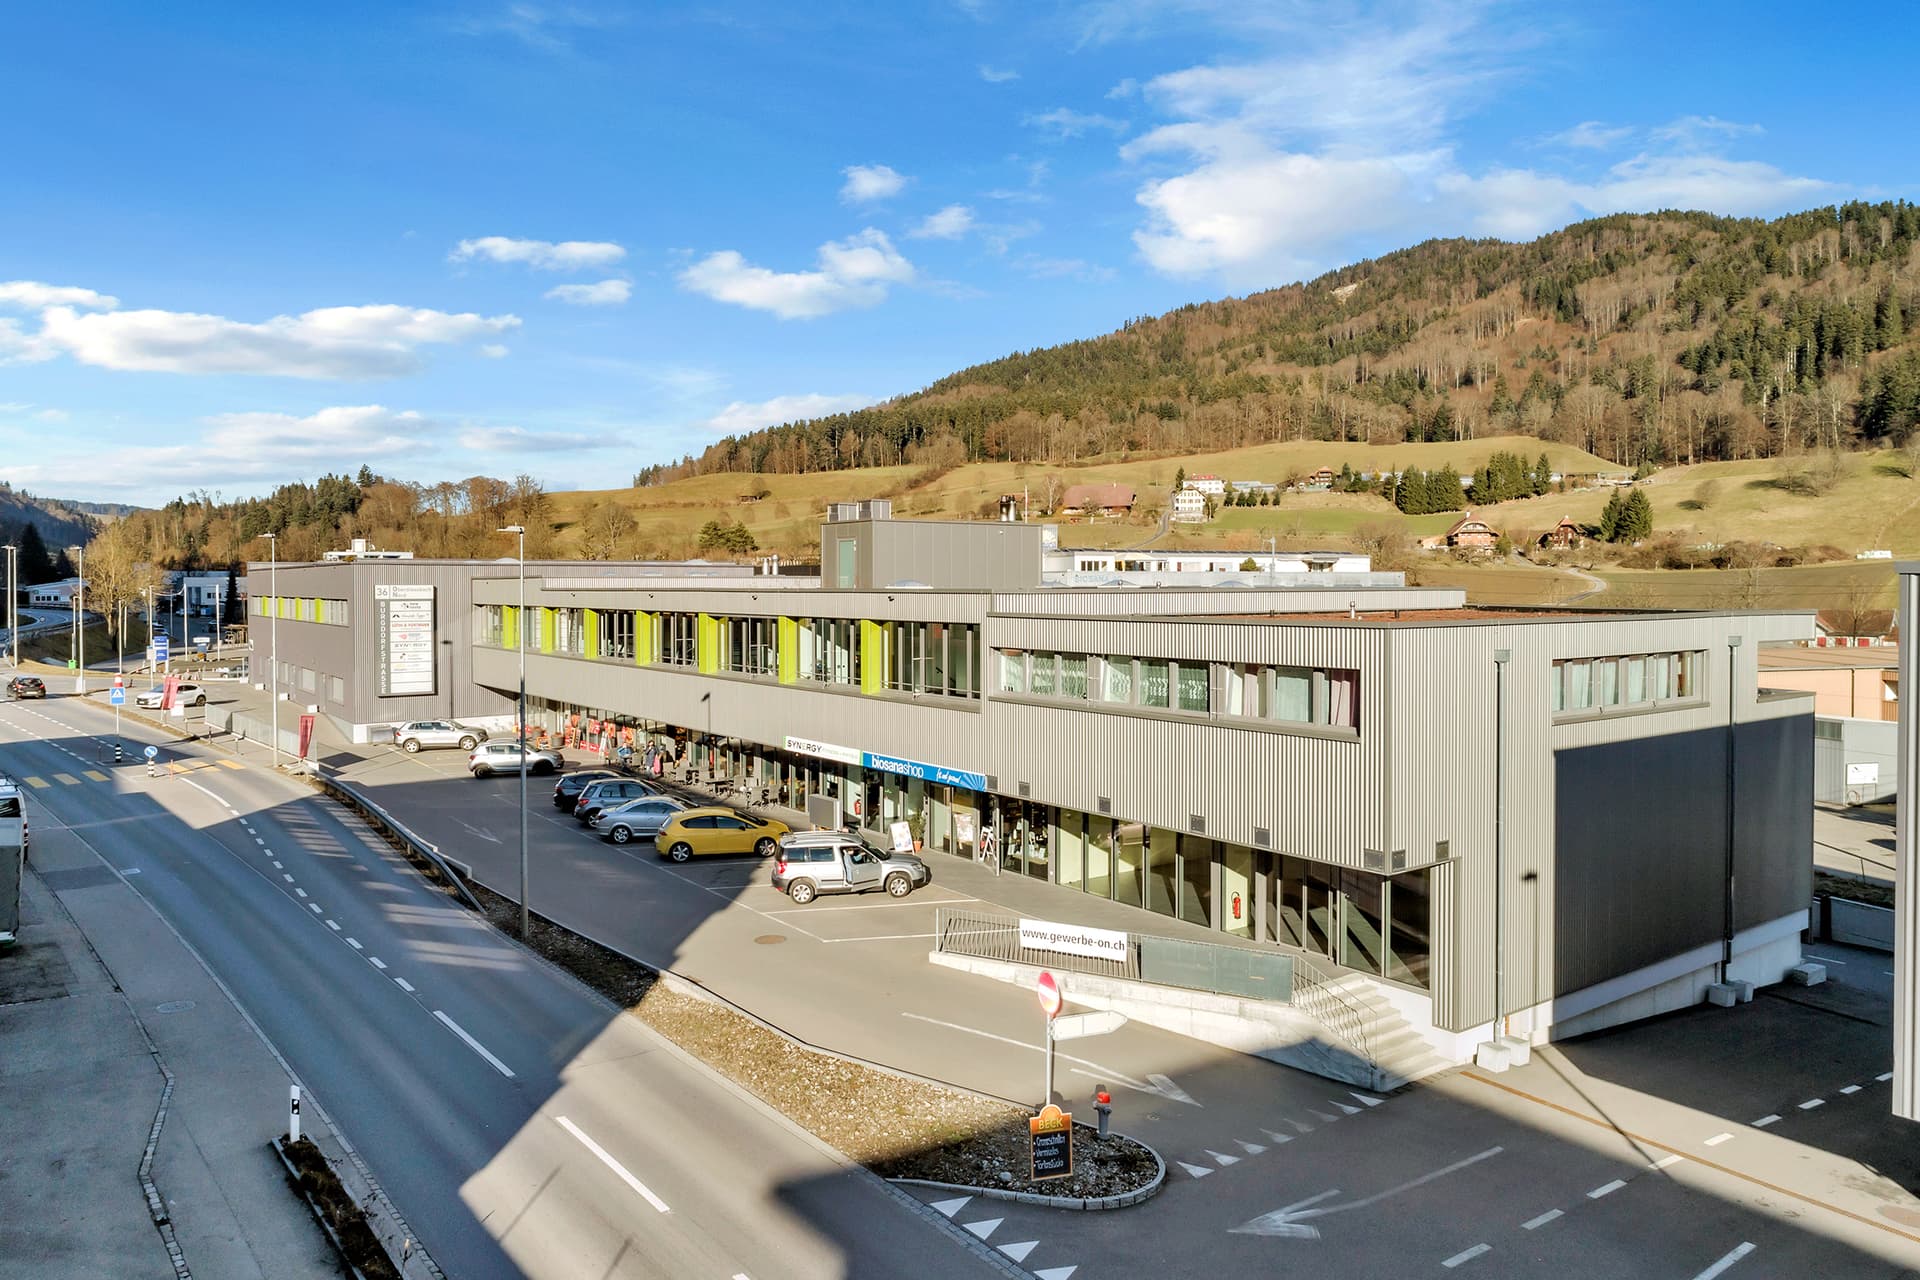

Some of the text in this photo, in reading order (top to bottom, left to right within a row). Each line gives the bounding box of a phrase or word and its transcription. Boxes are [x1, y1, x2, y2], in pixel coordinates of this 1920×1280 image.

[377, 587, 388, 596] 36
[787, 740, 822, 752] SYNERGY
[871, 755, 924, 779] biosanashop
[1022, 929, 1125, 951] www.gewerbe-on.ch
[1038, 1117, 1064, 1130] BECK
